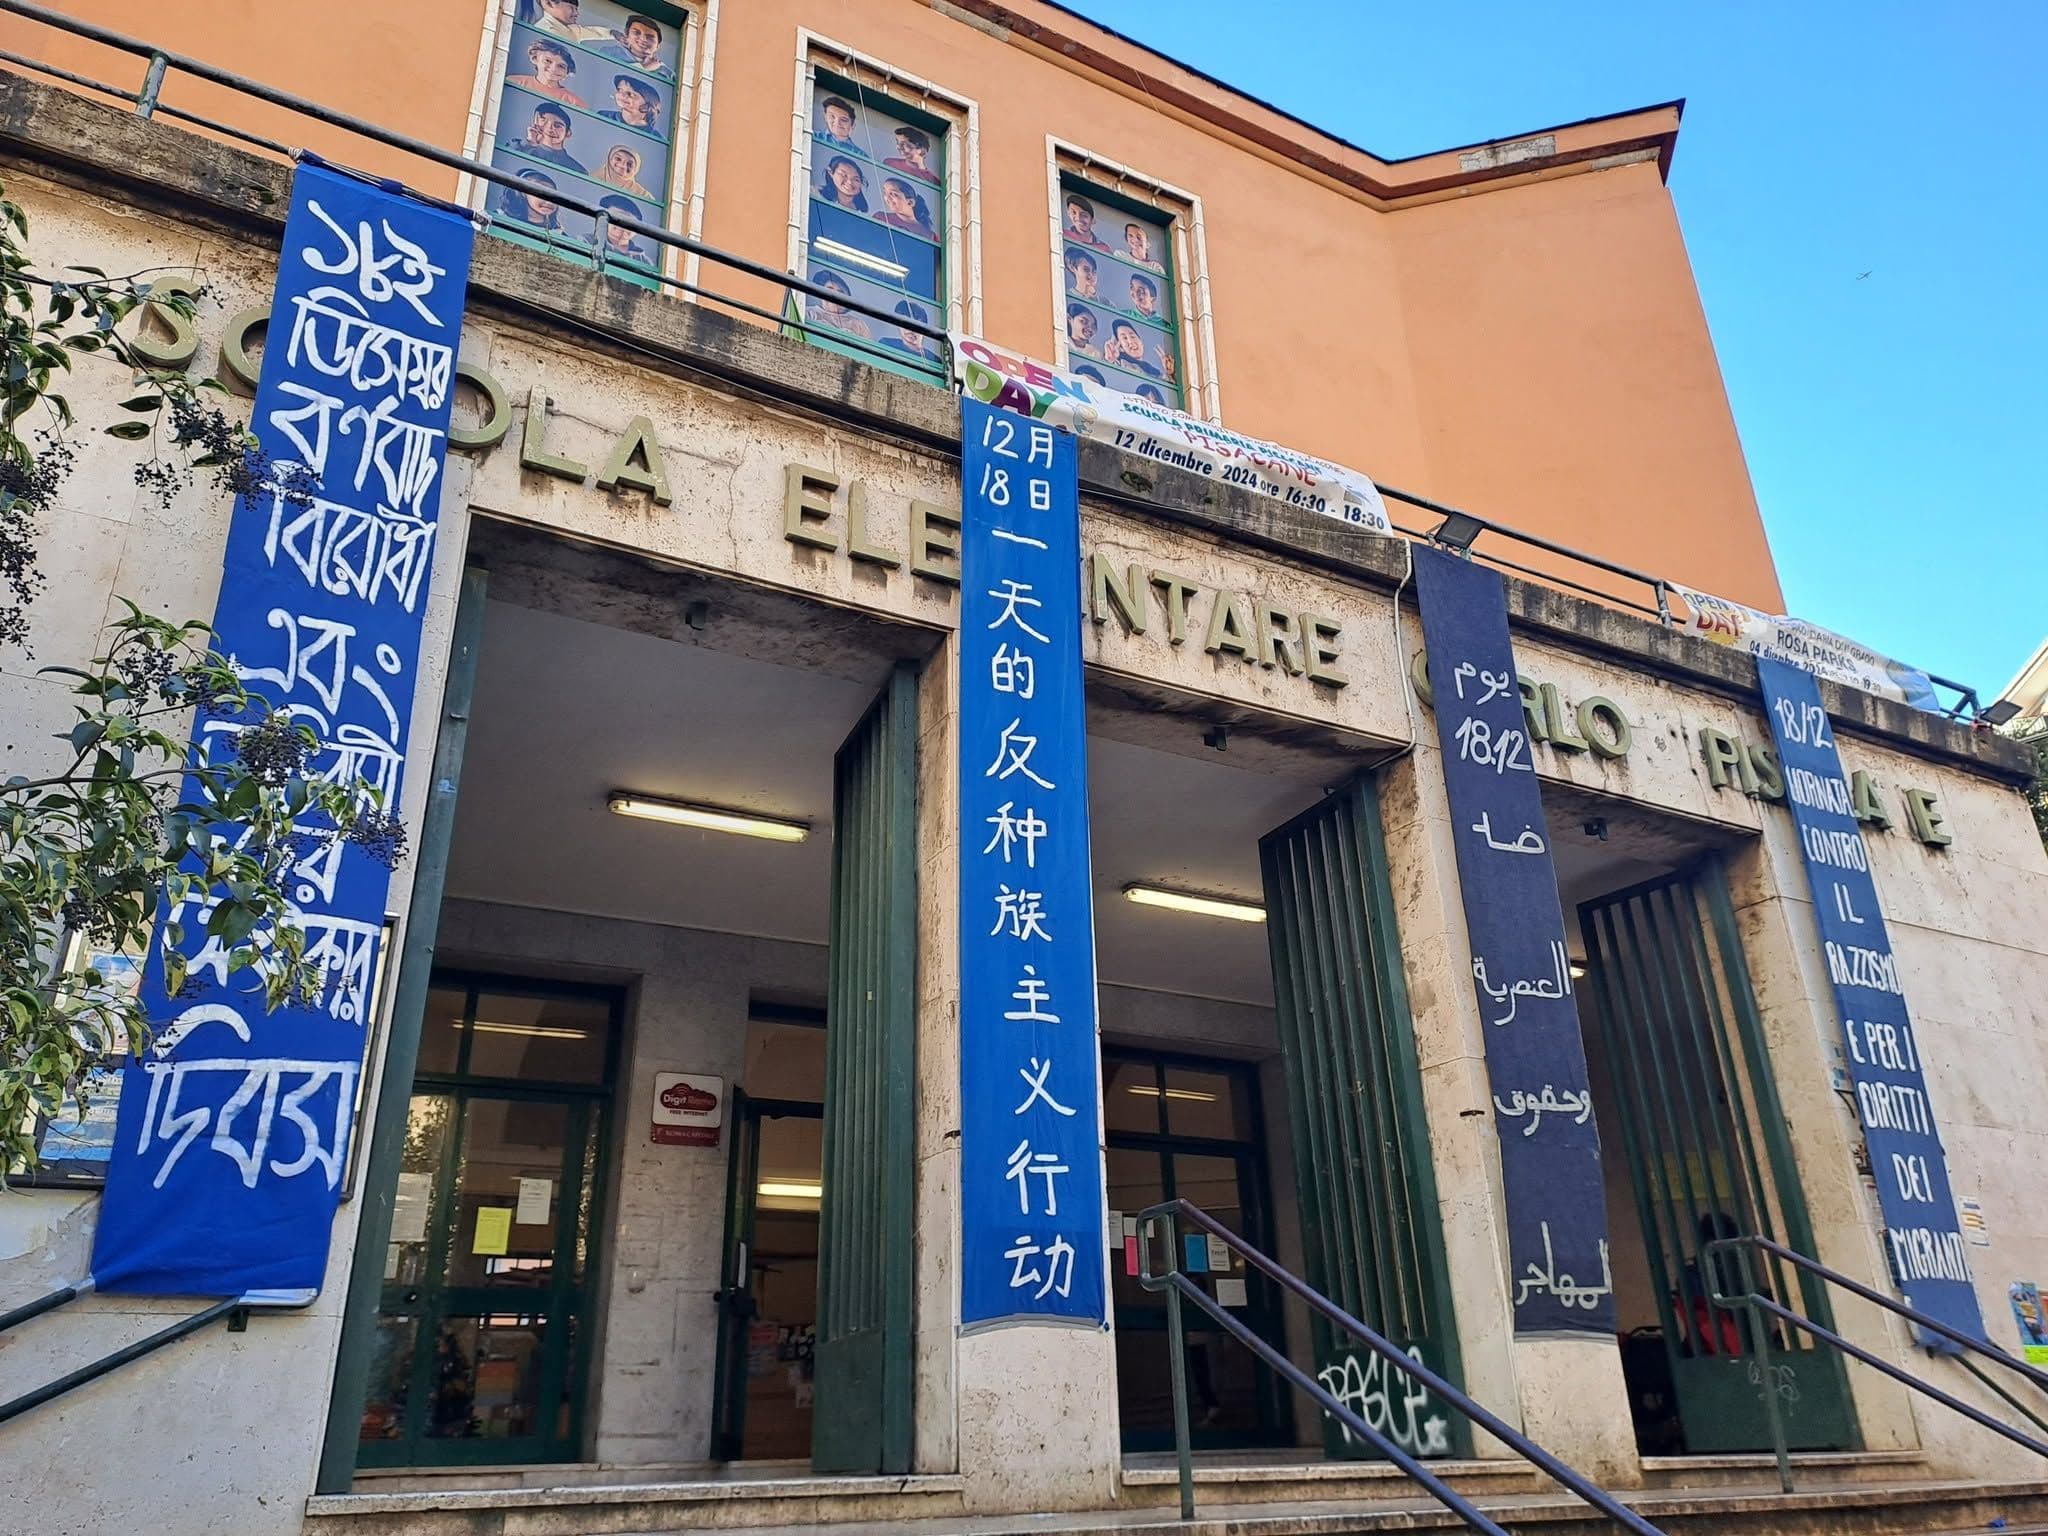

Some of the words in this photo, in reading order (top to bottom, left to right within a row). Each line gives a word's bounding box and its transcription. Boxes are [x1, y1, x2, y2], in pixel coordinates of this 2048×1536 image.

[959, 341, 1091, 403] OPEN
[965, 360, 1059, 419] DAY
[1122, 402, 1180, 426] SCUOLA
[1115, 429, 1135, 449] 12
[1139, 437, 1213, 475] dicembre
[1222, 464, 1257, 488] 2024
[1260, 480, 1279, 496] ore
[1286, 486, 1326, 512] 16:30
[1343, 504, 1385, 530] 18:30
[128, 275, 672, 508] SCOLA
[784, 462, 1350, 689] ELENTARE
[1411, 649, 1632, 759] RLO
[1683, 592, 1730, 611] OPEN
[1695, 606, 1741, 637] DAY
[1750, 640, 1760, 654] 04
[1778, 629, 1810, 659] ROSA
[1813, 645, 1858, 675] PARKS
[1454, 661, 1512, 706] يوم
[1455, 716, 1534, 775] 18.12
[1774, 697, 1833, 749] 18/12
[1801, 823, 1867, 873] CONTRO
[1833, 882, 1865, 924] IL
[1824, 940, 1905, 995] RAZZISMO
[1845, 1019, 1866, 1064] E
[1863, 1021, 1906, 1071] PER
[1902, 1025, 1917, 1072] I
[1857, 1080, 1930, 1136] DIRITTI
[1892, 1152, 1934, 1203] DEI
